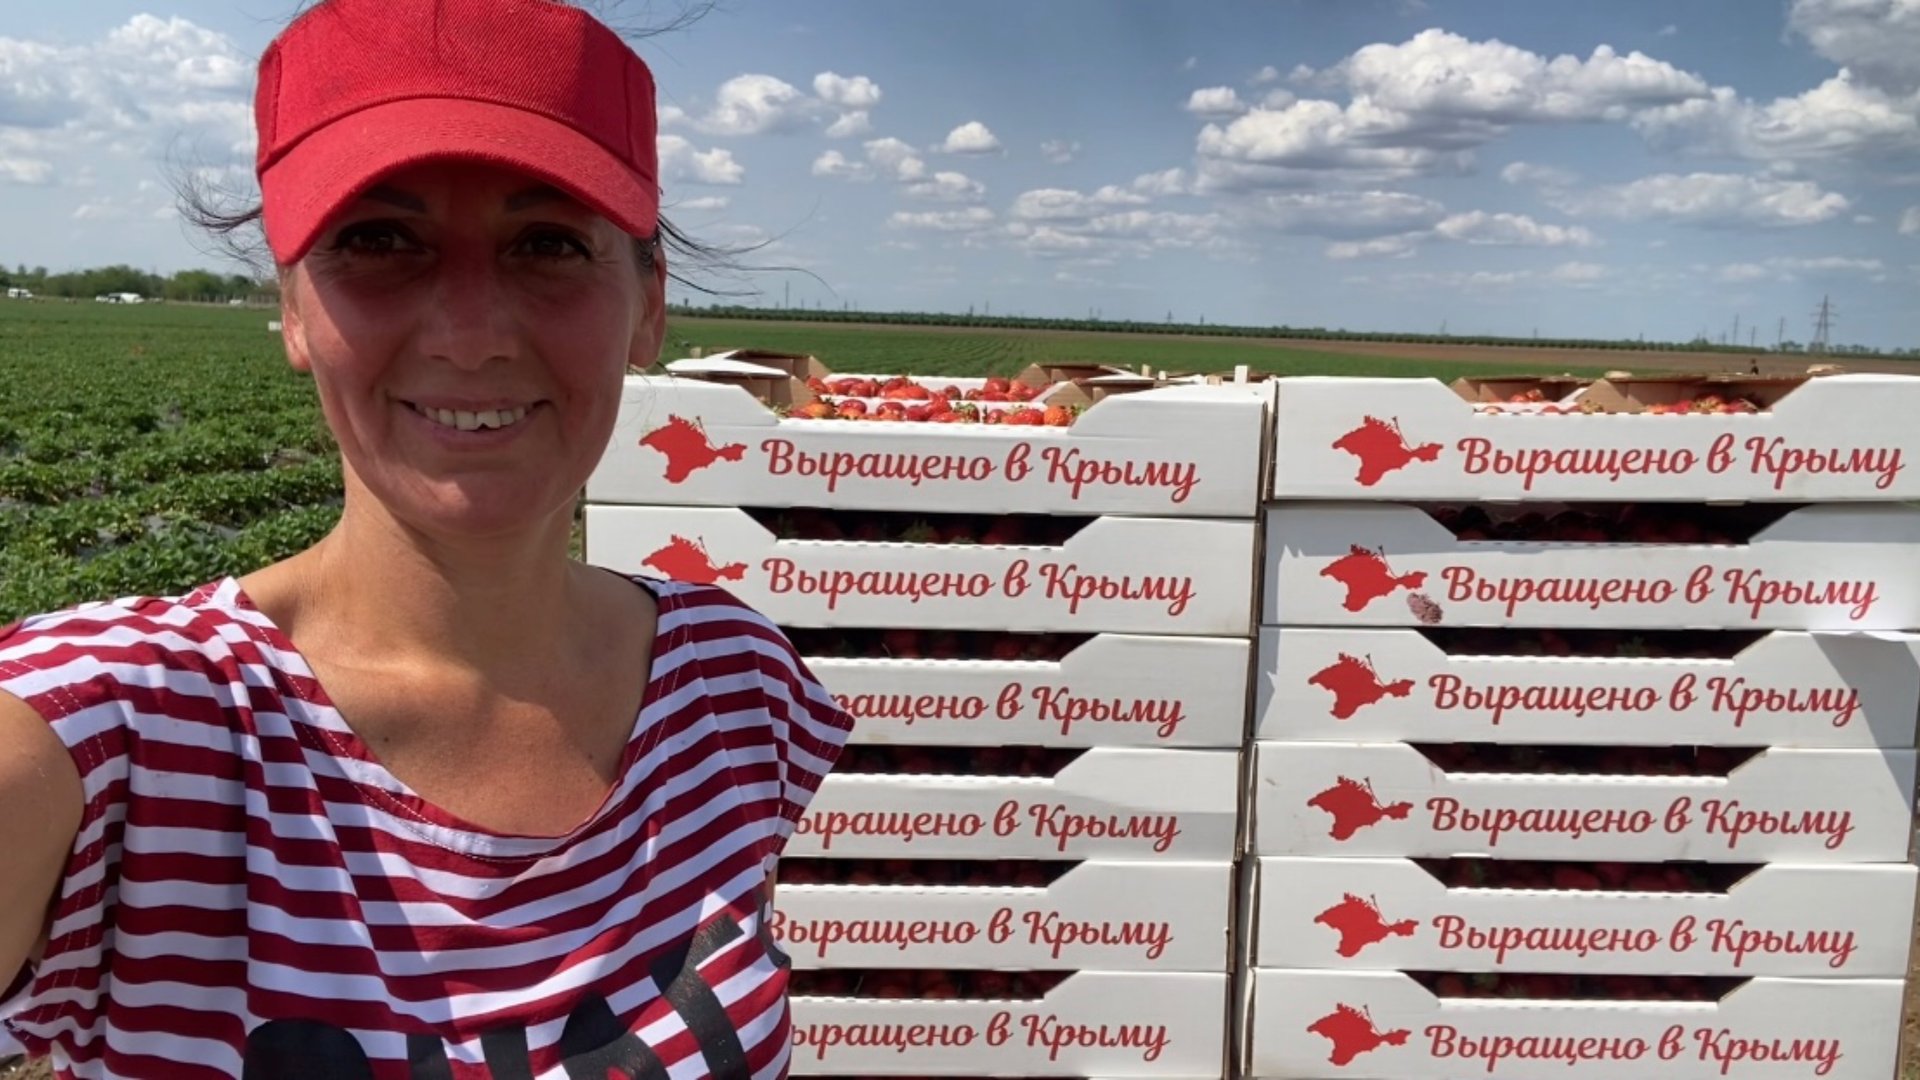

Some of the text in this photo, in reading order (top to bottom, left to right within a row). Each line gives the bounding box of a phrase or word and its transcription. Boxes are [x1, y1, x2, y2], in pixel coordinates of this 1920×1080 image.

[761, 438, 1198, 502] Выращено в Крыму
[1456, 433, 1903, 492] Выращено в Крыму
[762, 557, 1194, 615] Выращено в Крыму
[1440, 565, 1878, 620] Выращено в Крыму
[830, 683, 1184, 737] ащено в Крыму
[1428, 673, 1859, 727] Выращено в Крыму
[794, 801, 1179, 852] ыращено в Крыму
[1427, 797, 1852, 847] Выращено в Крыму
[987, 908, 1014, 943] в
[1022, 910, 1171, 958] Крыму
[1432, 914, 1856, 967] Выращено в Крыму
[792, 1013, 1168, 1060] ыращено в Крыму
[1423, 1024, 1841, 1075] Выращено в Крыму
